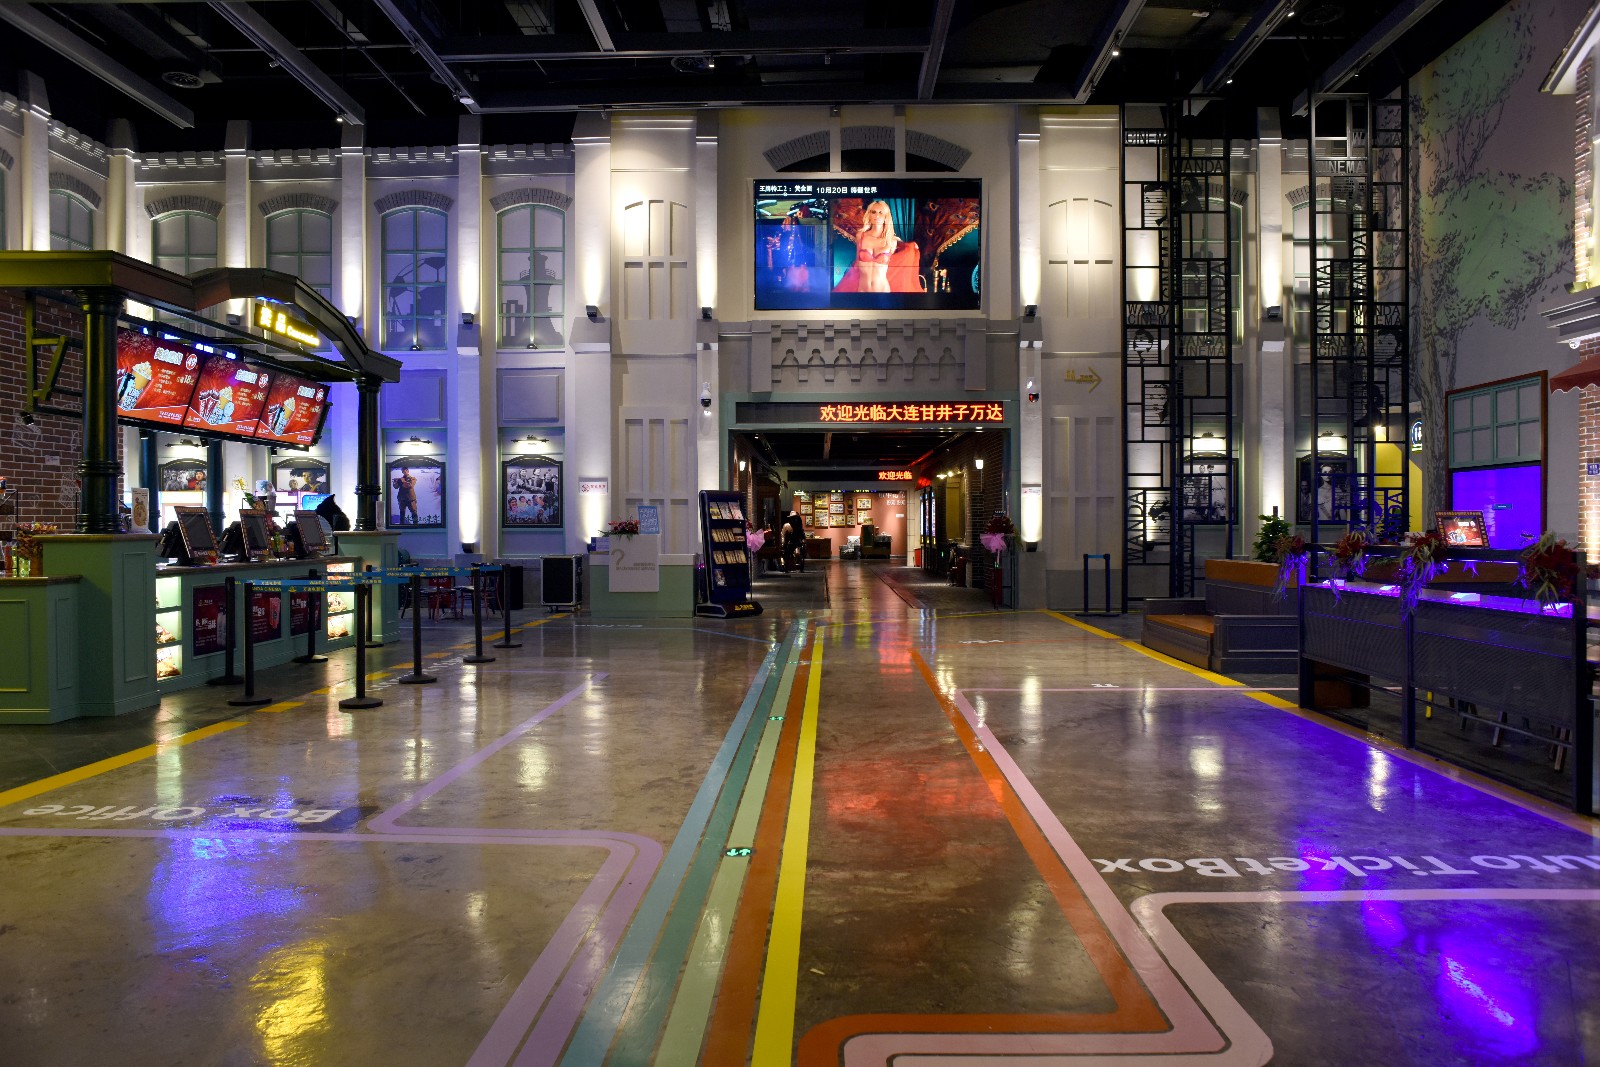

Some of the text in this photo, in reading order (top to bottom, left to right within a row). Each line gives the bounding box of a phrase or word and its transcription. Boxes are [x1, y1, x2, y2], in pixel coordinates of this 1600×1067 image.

[1127, 304, 1169, 315] WAND
[1354, 304, 1401, 316] WNDA
[1127, 314, 1168, 326] CINEM
[1318, 335, 1365, 347] WANA
[1179, 345, 1226, 358] INEMA
[1318, 346, 1367, 358] CINEA
[820, 404, 1004, 421] 欢迎光临大连甘井子万达
[878, 470, 913, 481] 欢迎光临
[1127, 491, 1145, 562] WANDA
[22, 804, 342, 823] Box Office
[1472, 854, 1600, 873] uto
